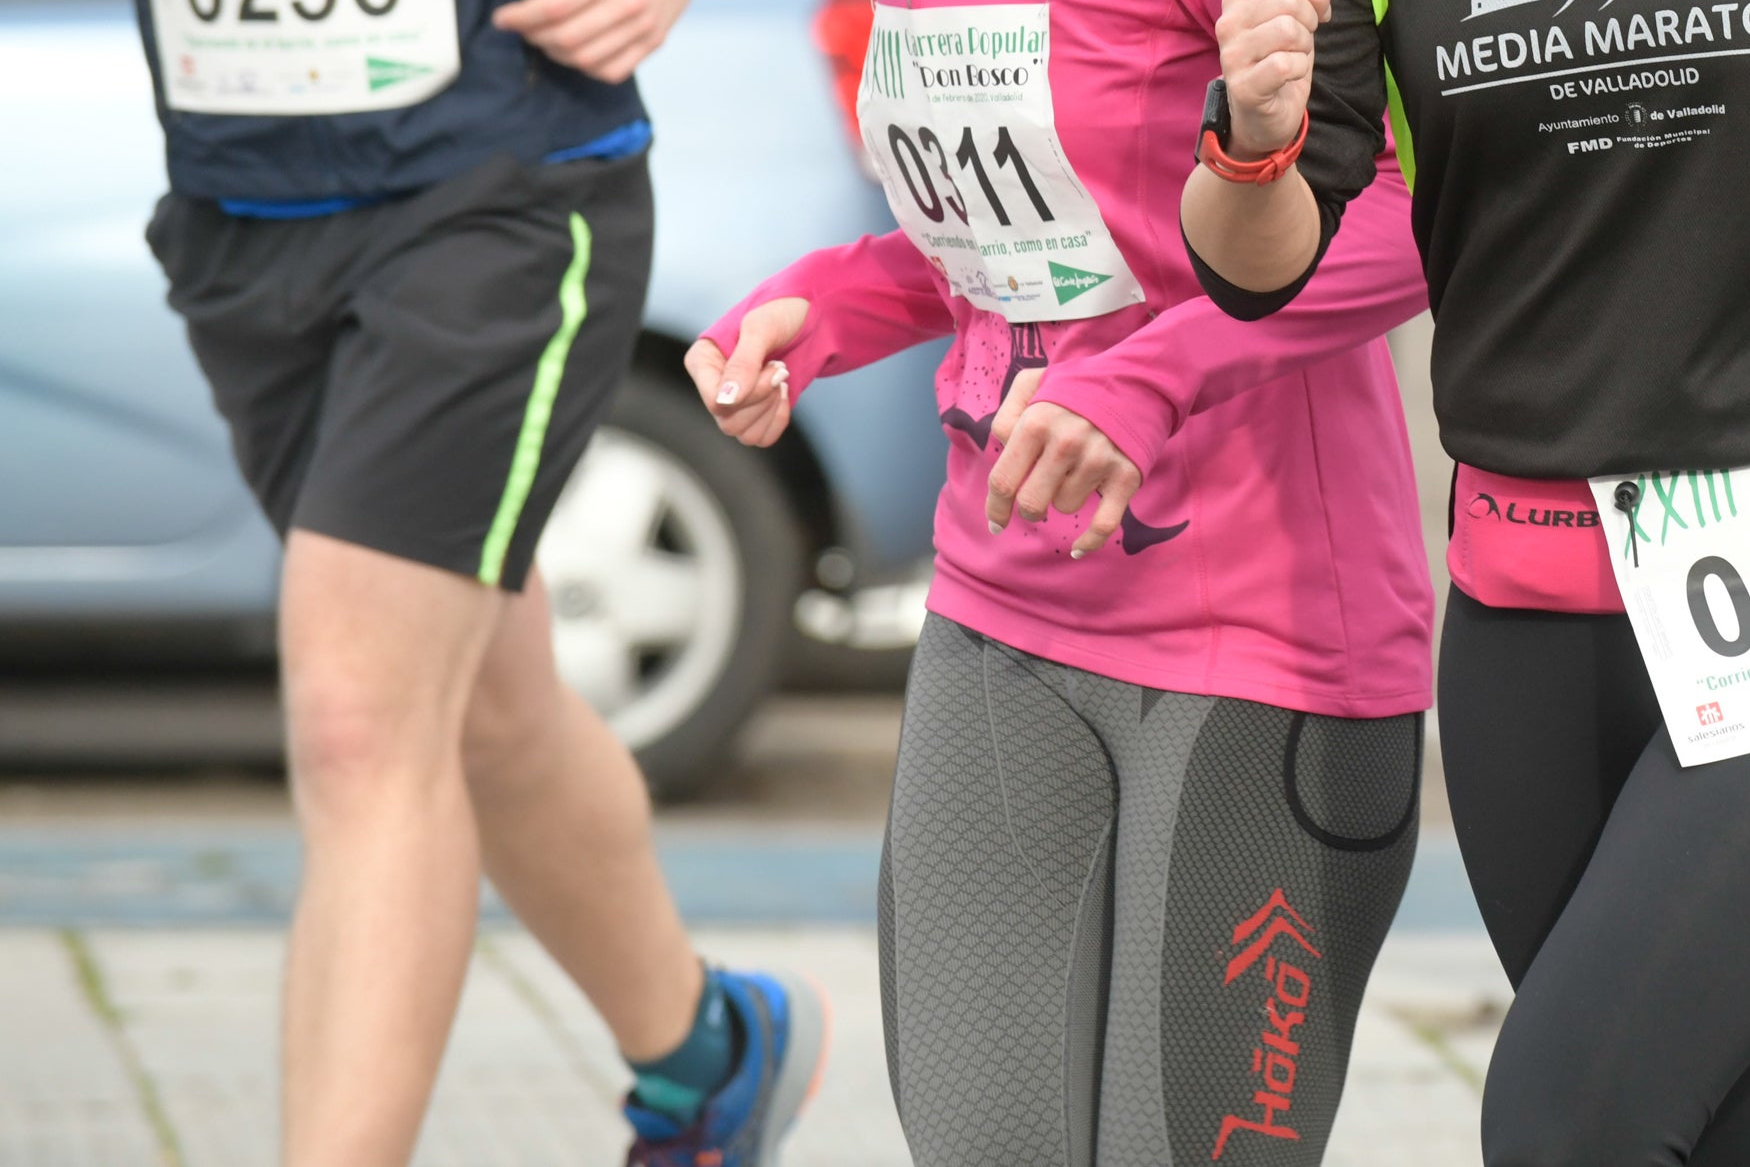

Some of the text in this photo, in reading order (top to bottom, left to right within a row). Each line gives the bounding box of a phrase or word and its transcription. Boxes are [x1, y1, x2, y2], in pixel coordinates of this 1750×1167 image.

[905, 28, 963, 57] Carrera
[967, 25, 1047, 59] Popular
[1435, 25, 1574, 81] MEDIA
[1549, 67, 1700, 100] DE VALLADOLID
[1538, 104, 1726, 133] Ayuntamiento de Valladolid
[1567, 128, 1711, 155] FMD Fundación Municipal
[1647, 137, 1692, 149] Deportes
[888, 123, 1055, 226] 0311
[980, 239, 1012, 257] arrio,
[1014, 238, 1043, 254] como
[1046, 237, 1058, 251] en
[1688, 722, 1745, 744] salesianos
